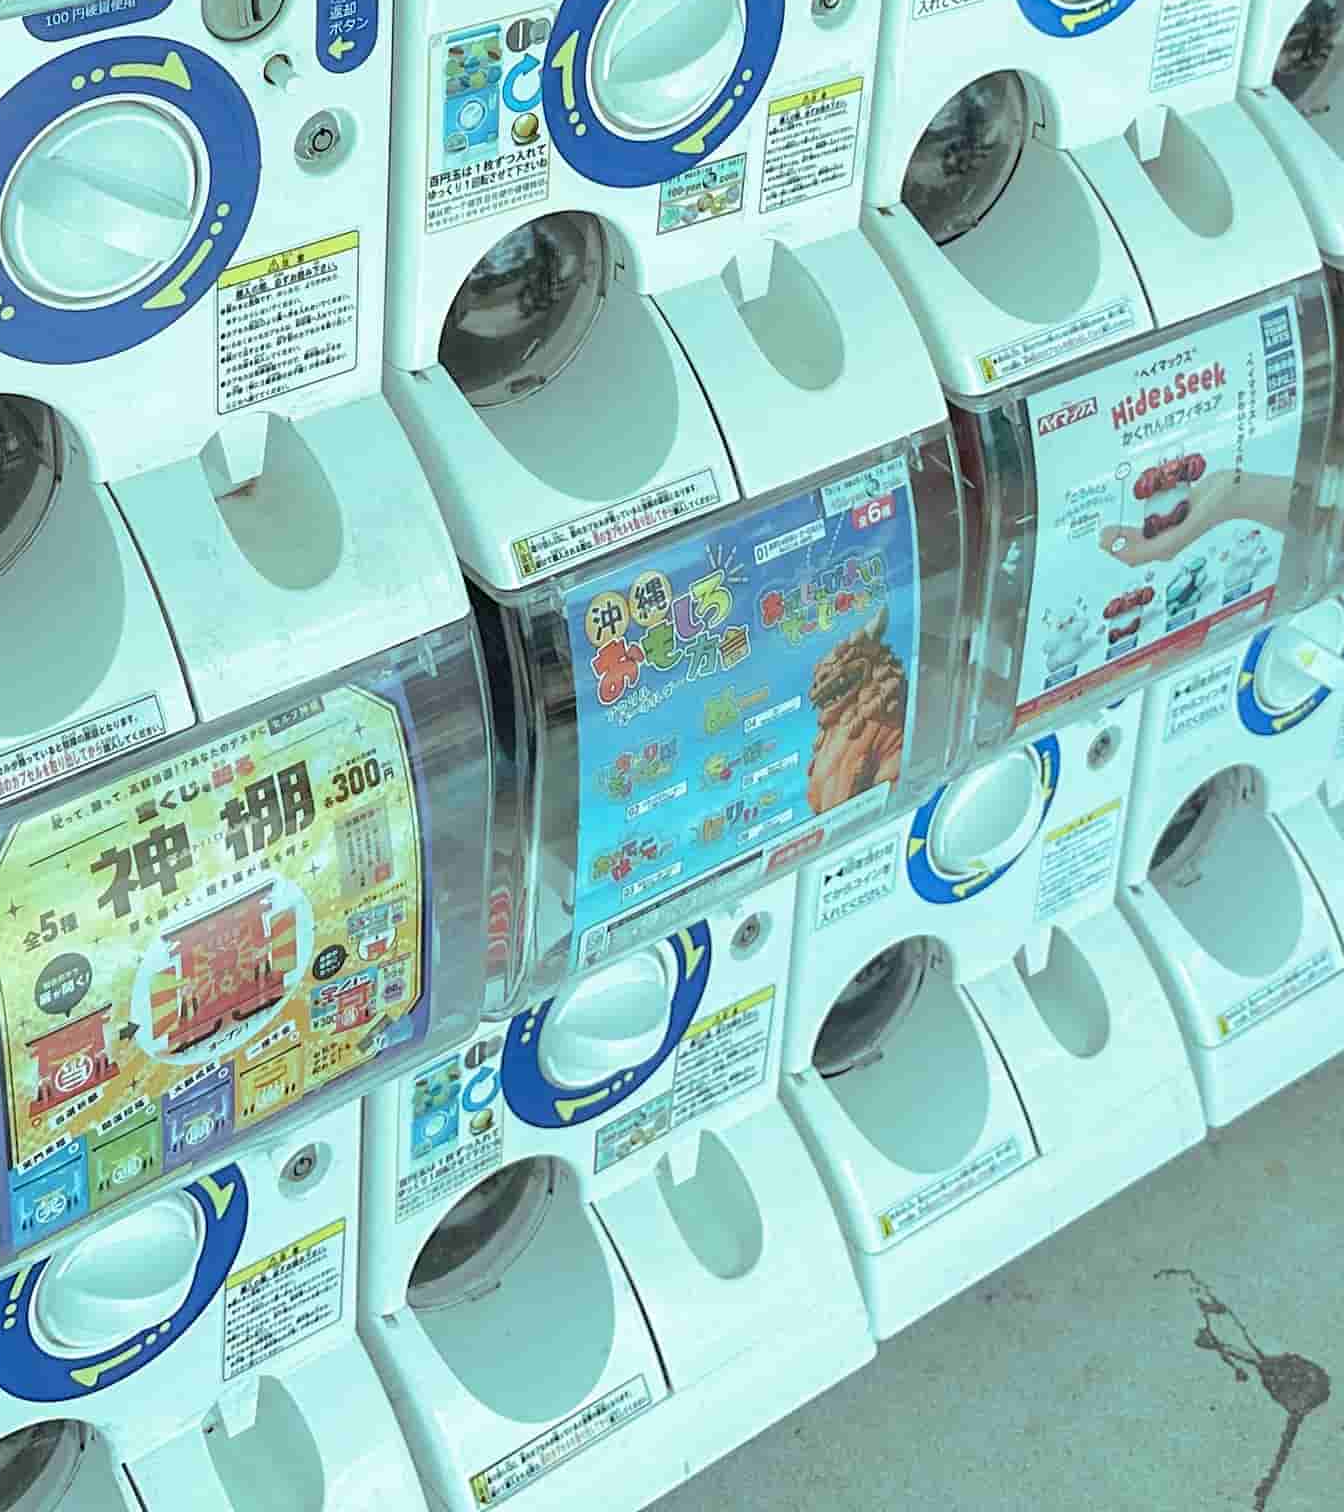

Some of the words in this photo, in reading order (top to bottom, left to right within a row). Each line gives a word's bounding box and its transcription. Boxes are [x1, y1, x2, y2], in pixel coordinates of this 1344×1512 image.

[329, 15, 369, 36] ボタン
[1110, 361, 1227, 431] Hide&Seek
[591, 576, 671, 641] 沖縄
[90, 760, 317, 920] 神棚
[23, 906, 80, 953] 全5種
